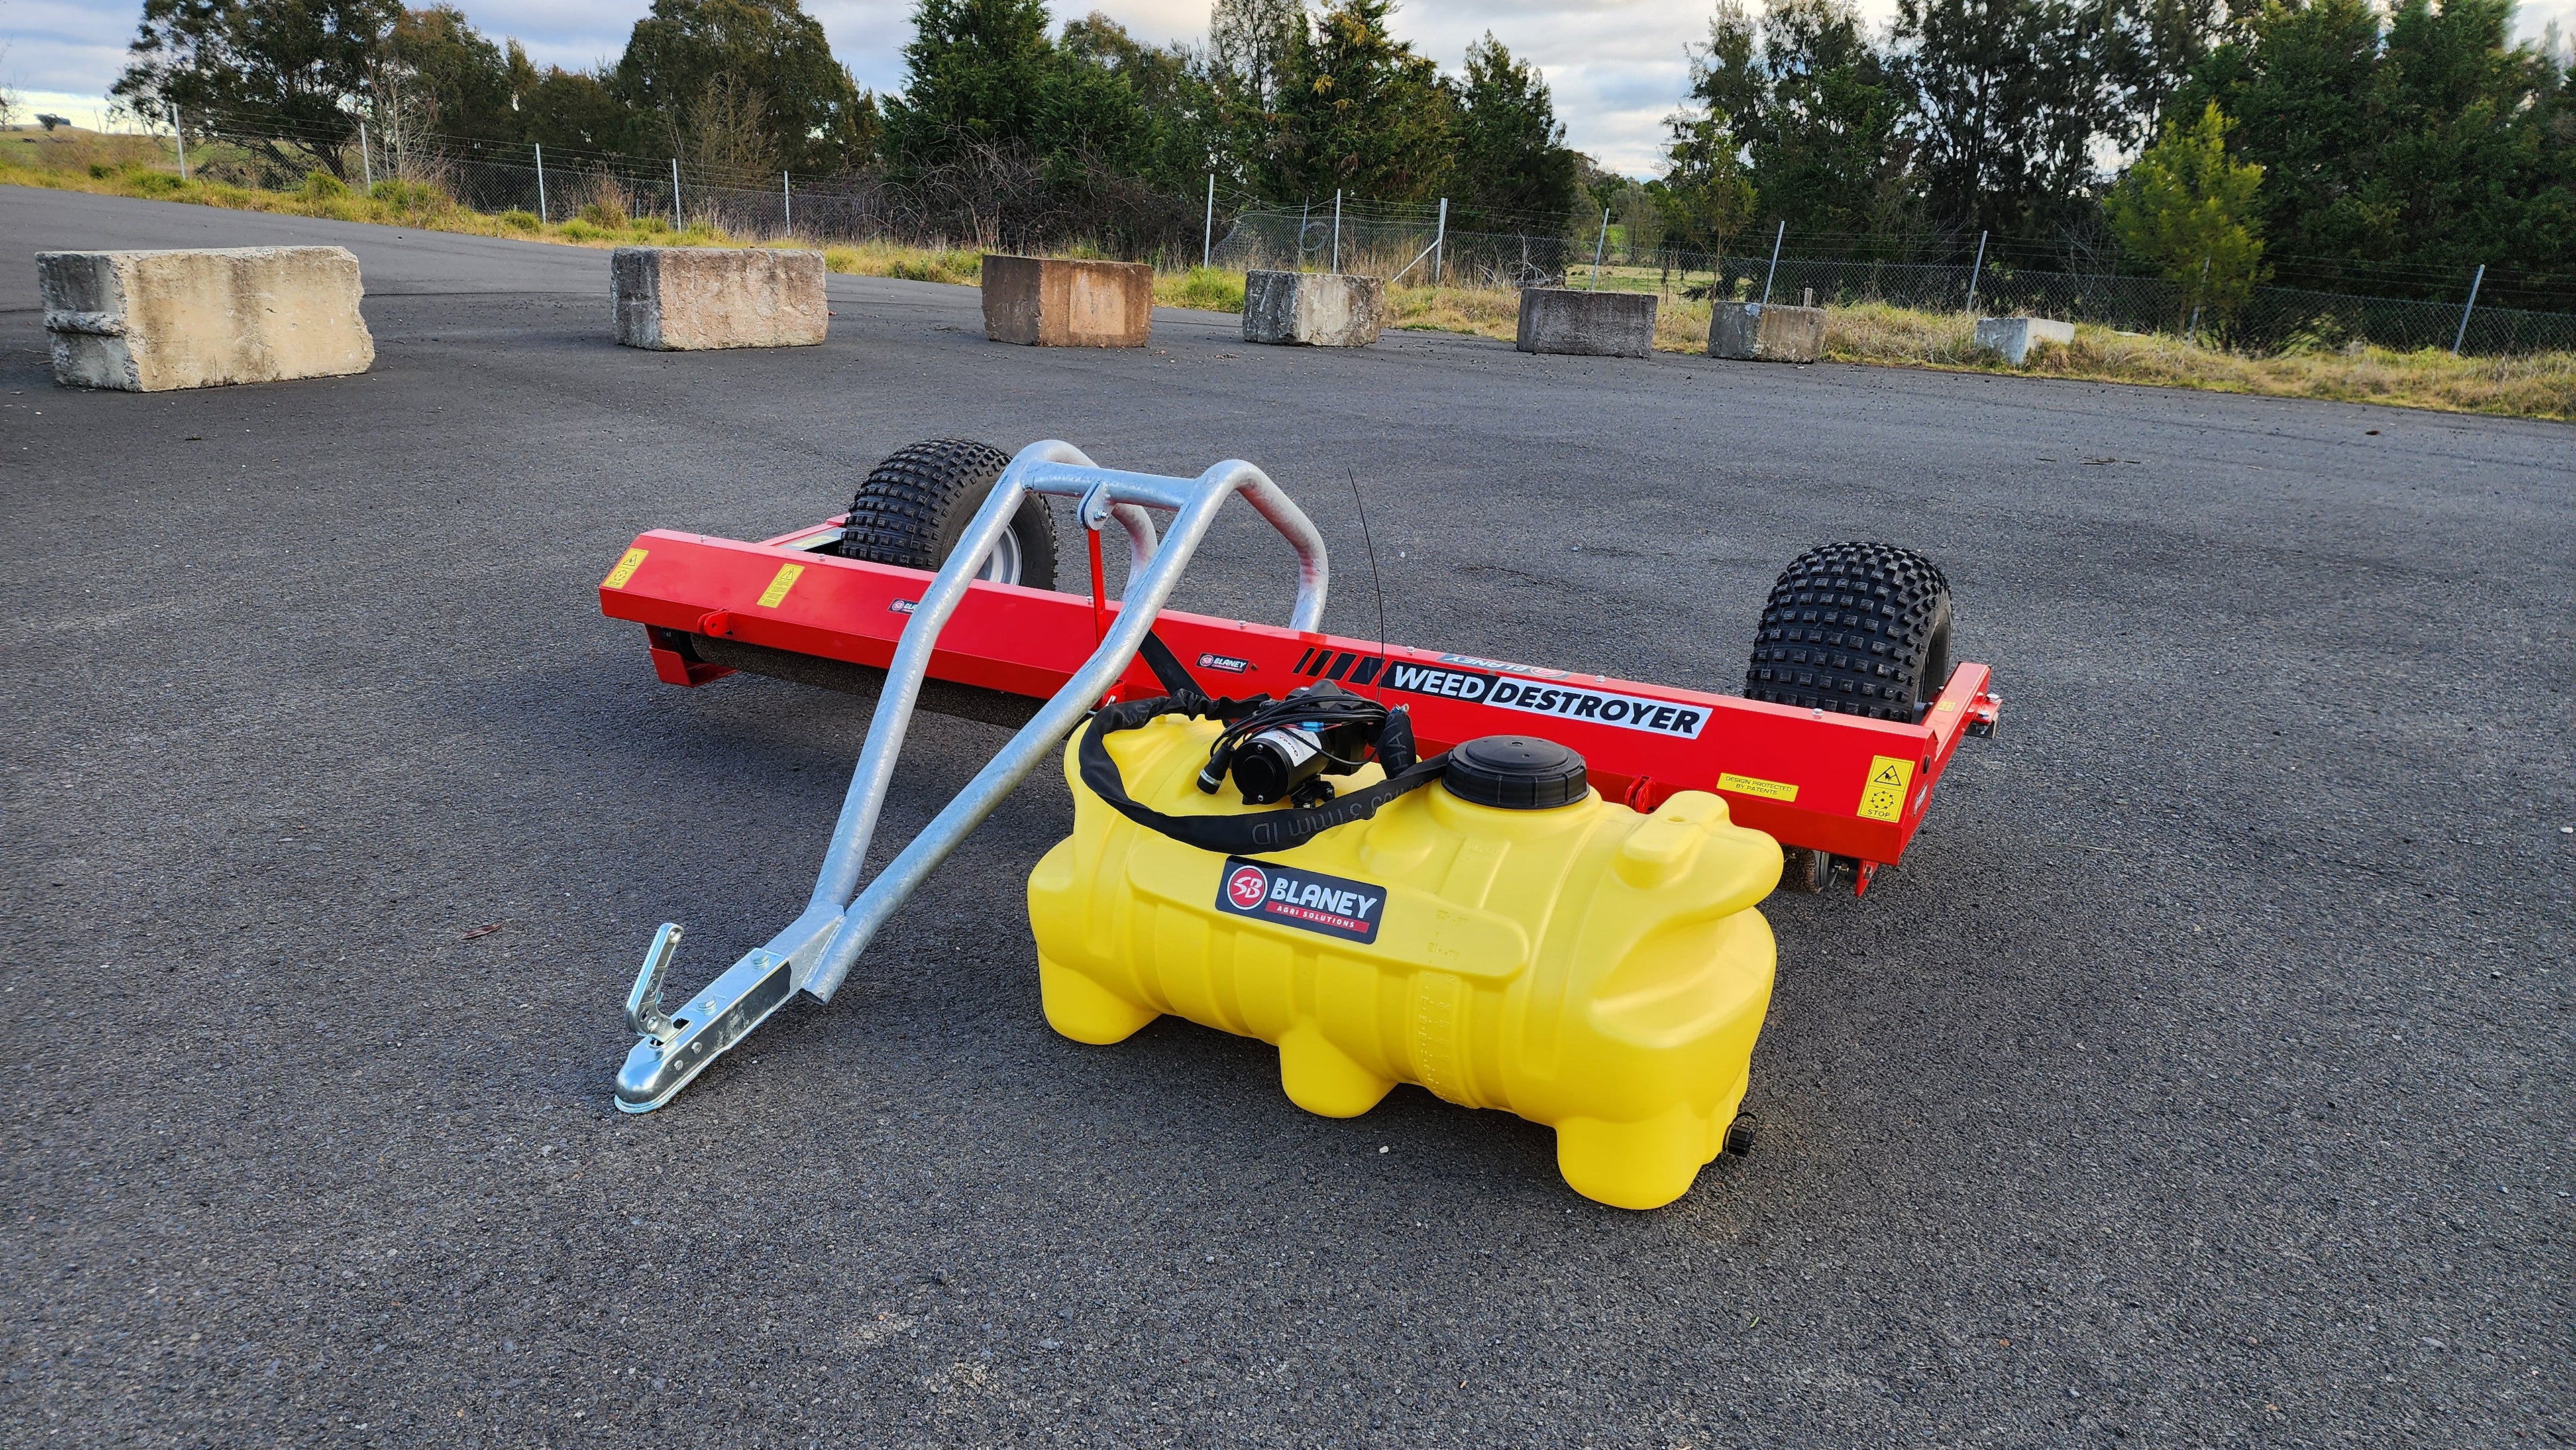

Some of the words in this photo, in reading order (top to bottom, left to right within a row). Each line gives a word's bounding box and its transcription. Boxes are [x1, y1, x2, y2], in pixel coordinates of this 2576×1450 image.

[1214, 658, 1246, 668] BLANEY
[1394, 665, 1485, 699] WEED
[1491, 682, 1700, 734] DESTROYER
[1725, 776, 1751, 785] DESIGN
[1752, 781, 1792, 792] PROTECTED
[1746, 785, 1778, 795] PATENTS
[1868, 809, 1890, 818] STOP
[1270, 877, 1377, 919] BLANEY
[1277, 905, 1299, 916] AGRI
[1303, 911, 1355, 928] SOLUTIONS
